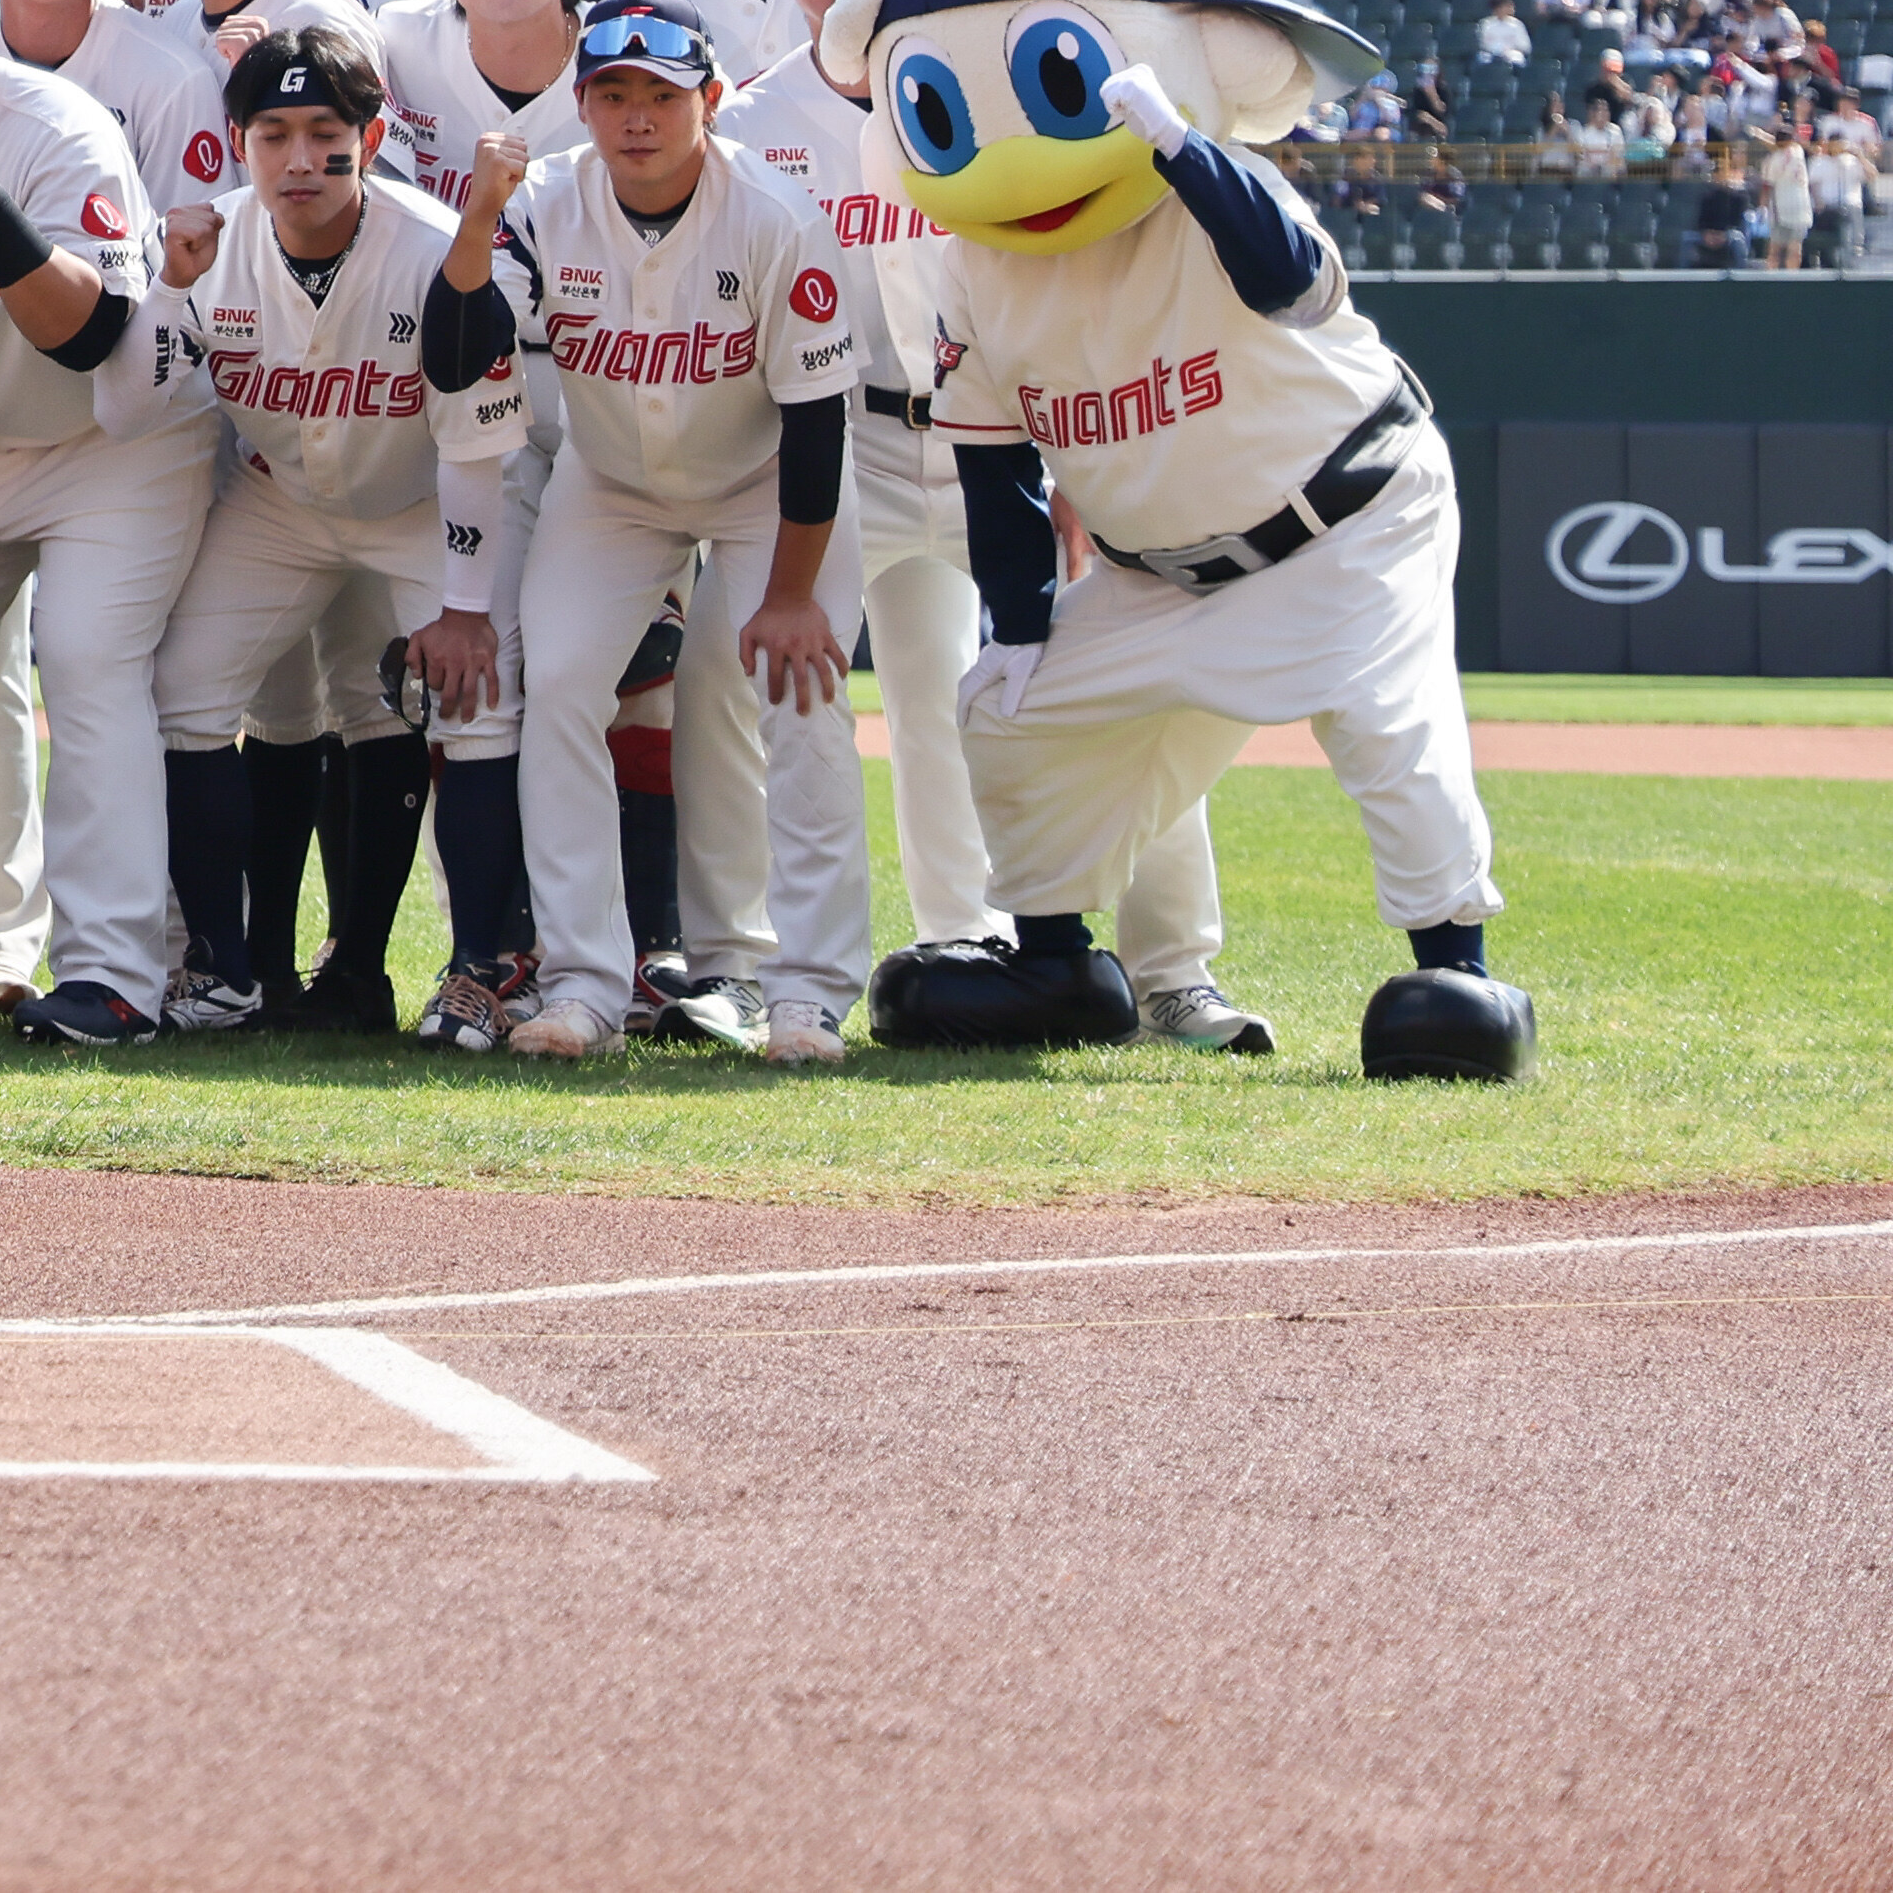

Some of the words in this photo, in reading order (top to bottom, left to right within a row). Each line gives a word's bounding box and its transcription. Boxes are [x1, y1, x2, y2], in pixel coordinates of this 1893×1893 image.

[765, 147, 808, 163] BNK
[559, 267, 604, 285] BNK
[212, 308, 257, 325] BNK
[545, 312, 756, 386] Giants
[210, 349, 424, 419] Giants
[1018, 349, 1224, 449] Giants
